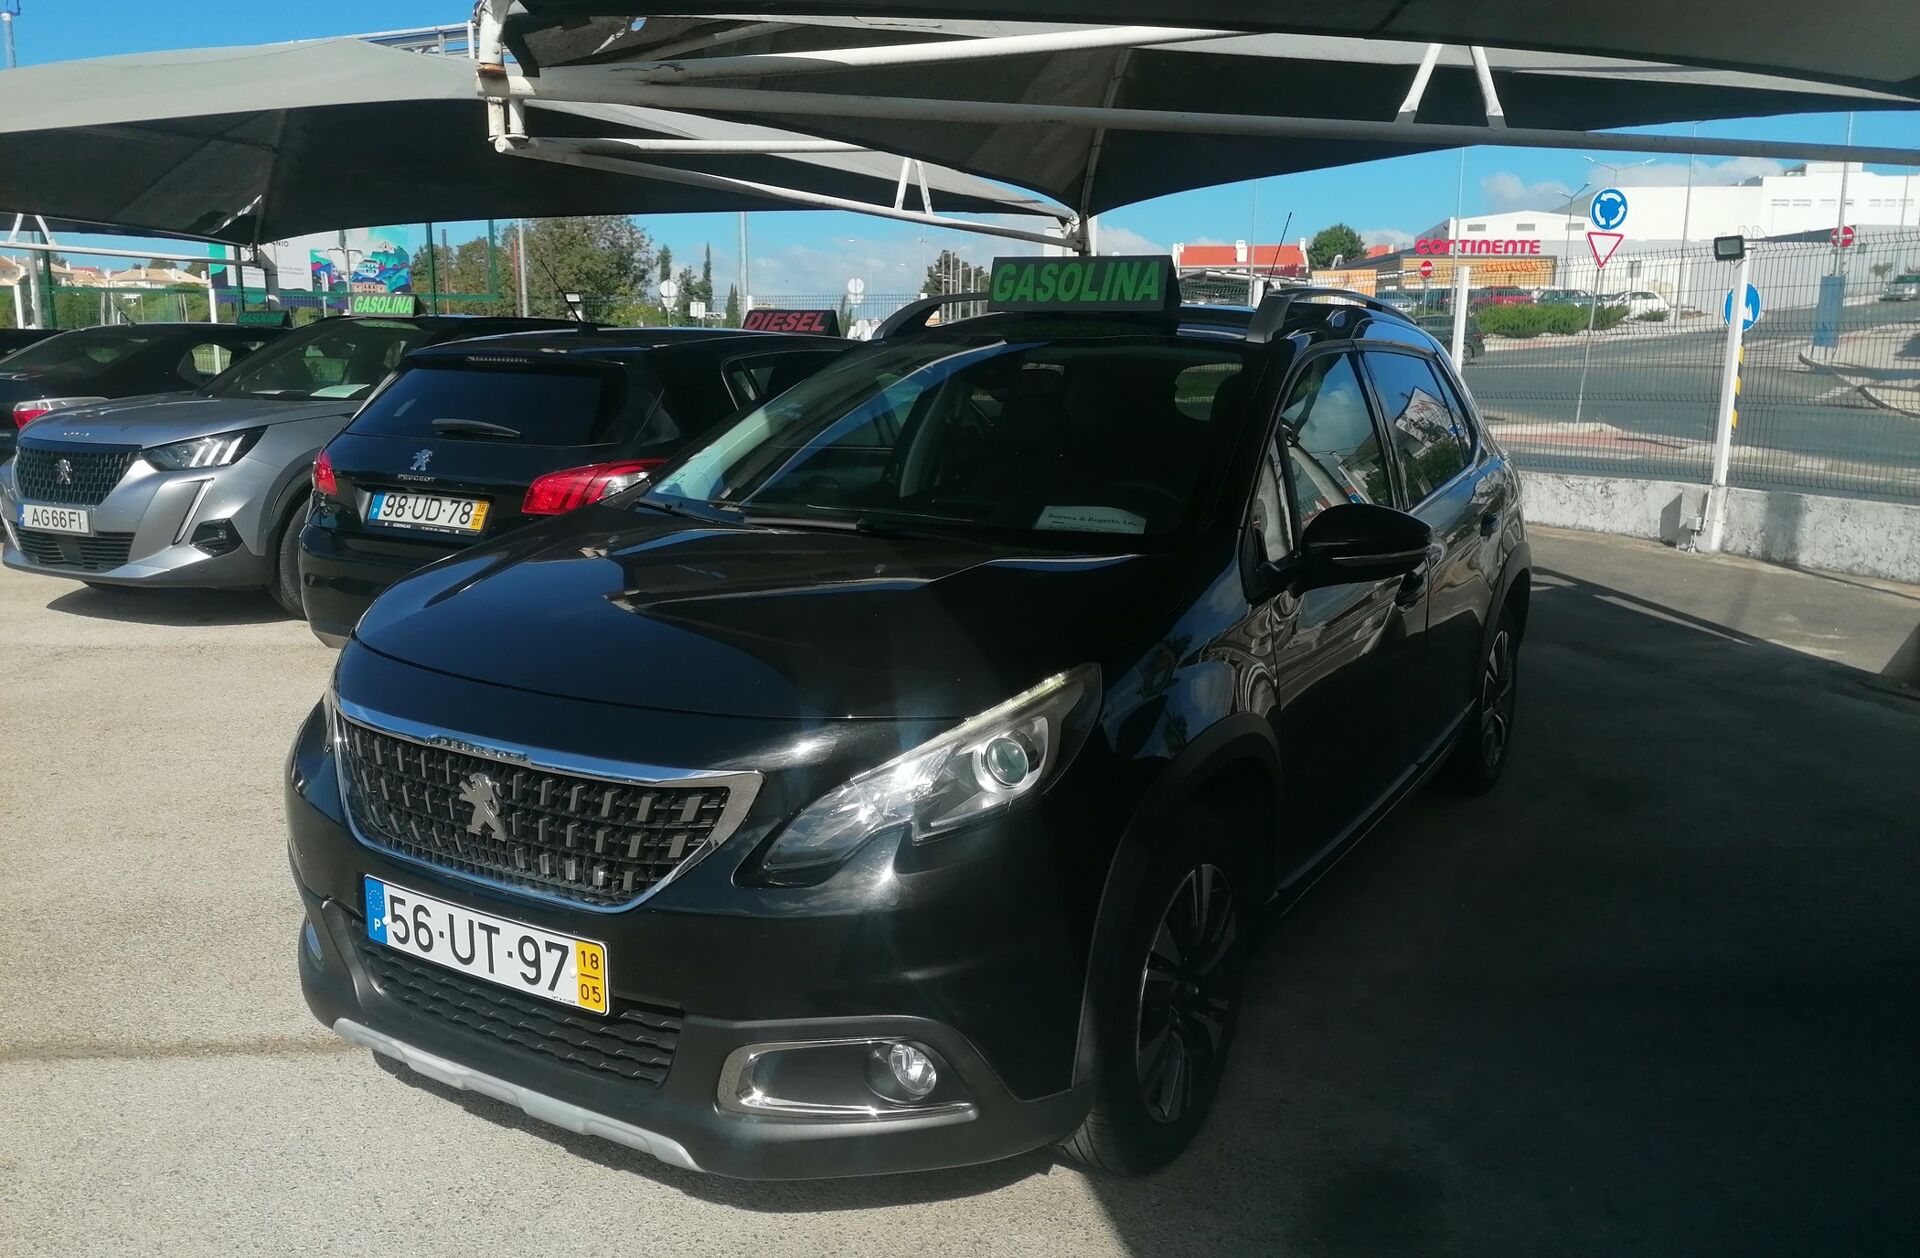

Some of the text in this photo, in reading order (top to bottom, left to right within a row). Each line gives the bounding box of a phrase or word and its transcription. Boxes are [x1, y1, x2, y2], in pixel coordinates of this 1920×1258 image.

[1415, 239, 1541, 255] CONTINENTE
[993, 261, 1160, 302] GASOLINA
[354, 295, 413, 314] GASOLINA
[744, 312, 825, 332] DIESEL
[374, 918, 381, 931] P
[580, 950, 599, 970] 18
[580, 984, 601, 1004] 05
